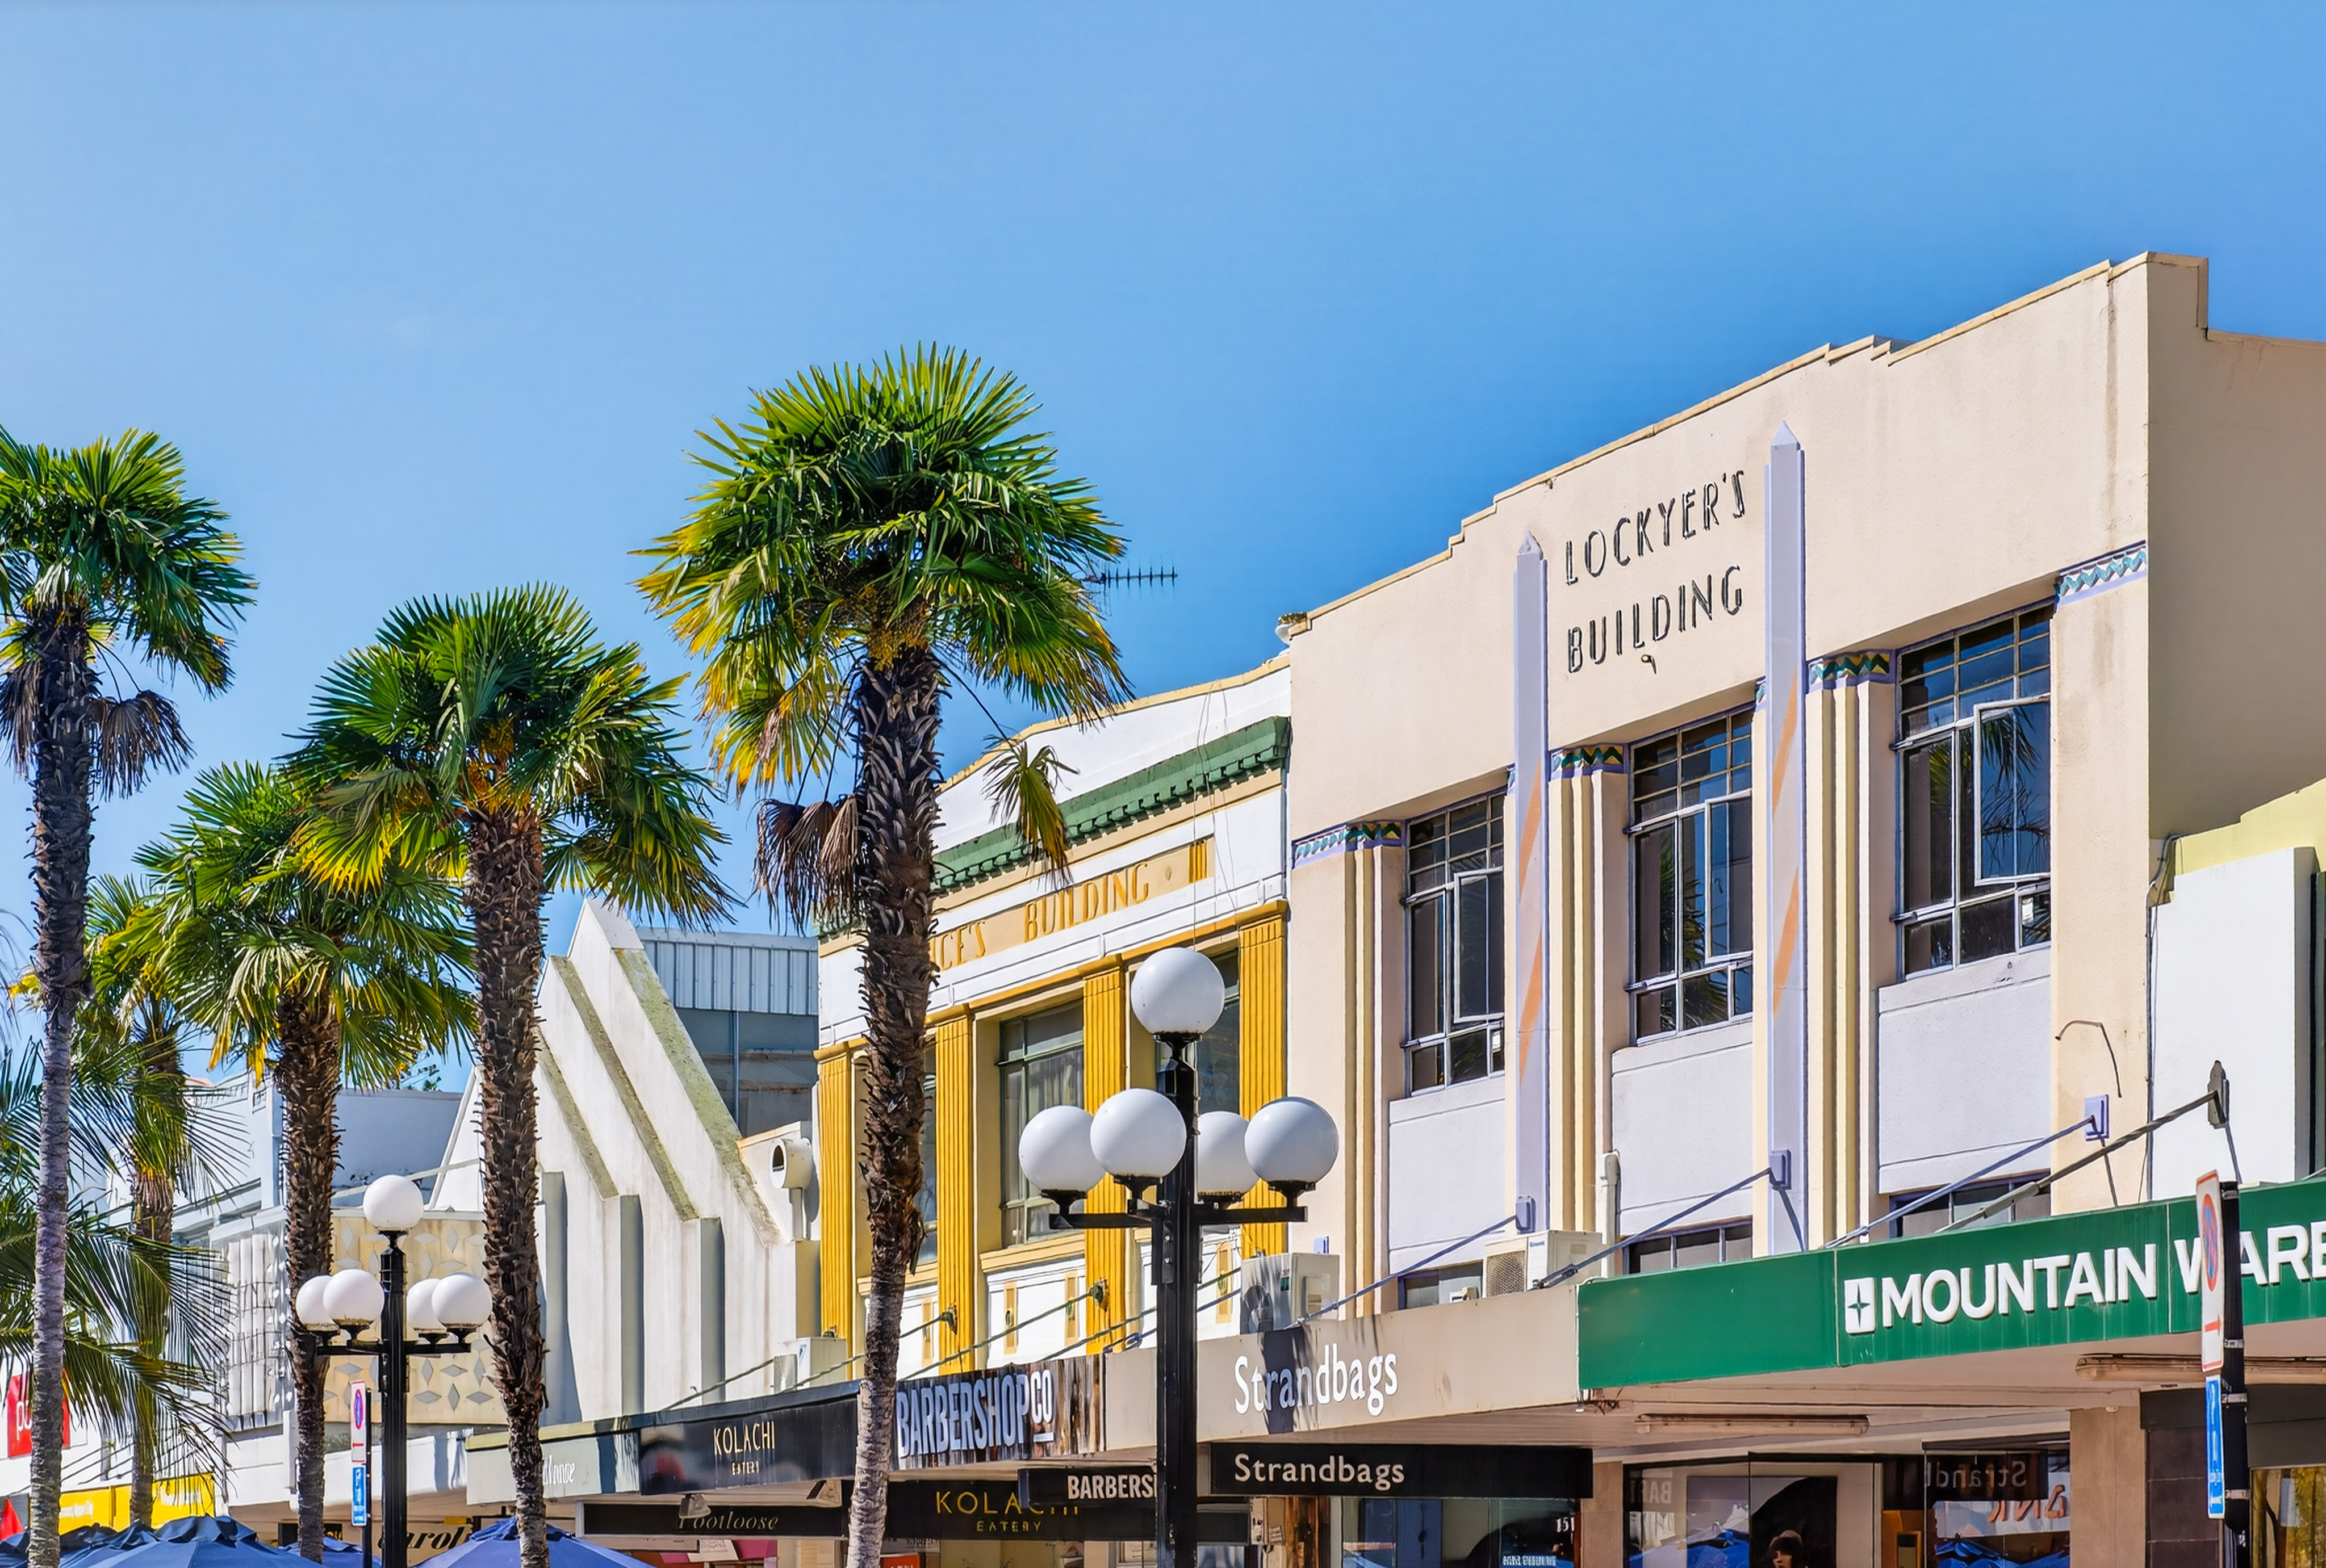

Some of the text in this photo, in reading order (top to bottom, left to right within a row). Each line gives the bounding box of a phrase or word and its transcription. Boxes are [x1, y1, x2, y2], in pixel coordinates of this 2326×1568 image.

[1566, 470, 1745, 586] LOCKYER'S
[1568, 565, 1742, 673] BUILDING
[1024, 862, 1149, 943] BUILDING
[1881, 1243, 2157, 1328] MOUNTAIN
[896, 1369, 1053, 1458] BARBERSHOP CO
[1235, 1343, 1398, 1416] Strandbags
[714, 1421, 775, 1455] KOLACHI
[1235, 1453, 1404, 1490] Strandbags
[1068, 1474, 1157, 1499] BARBERS
[976, 1521, 1042, 1532] EATERY
